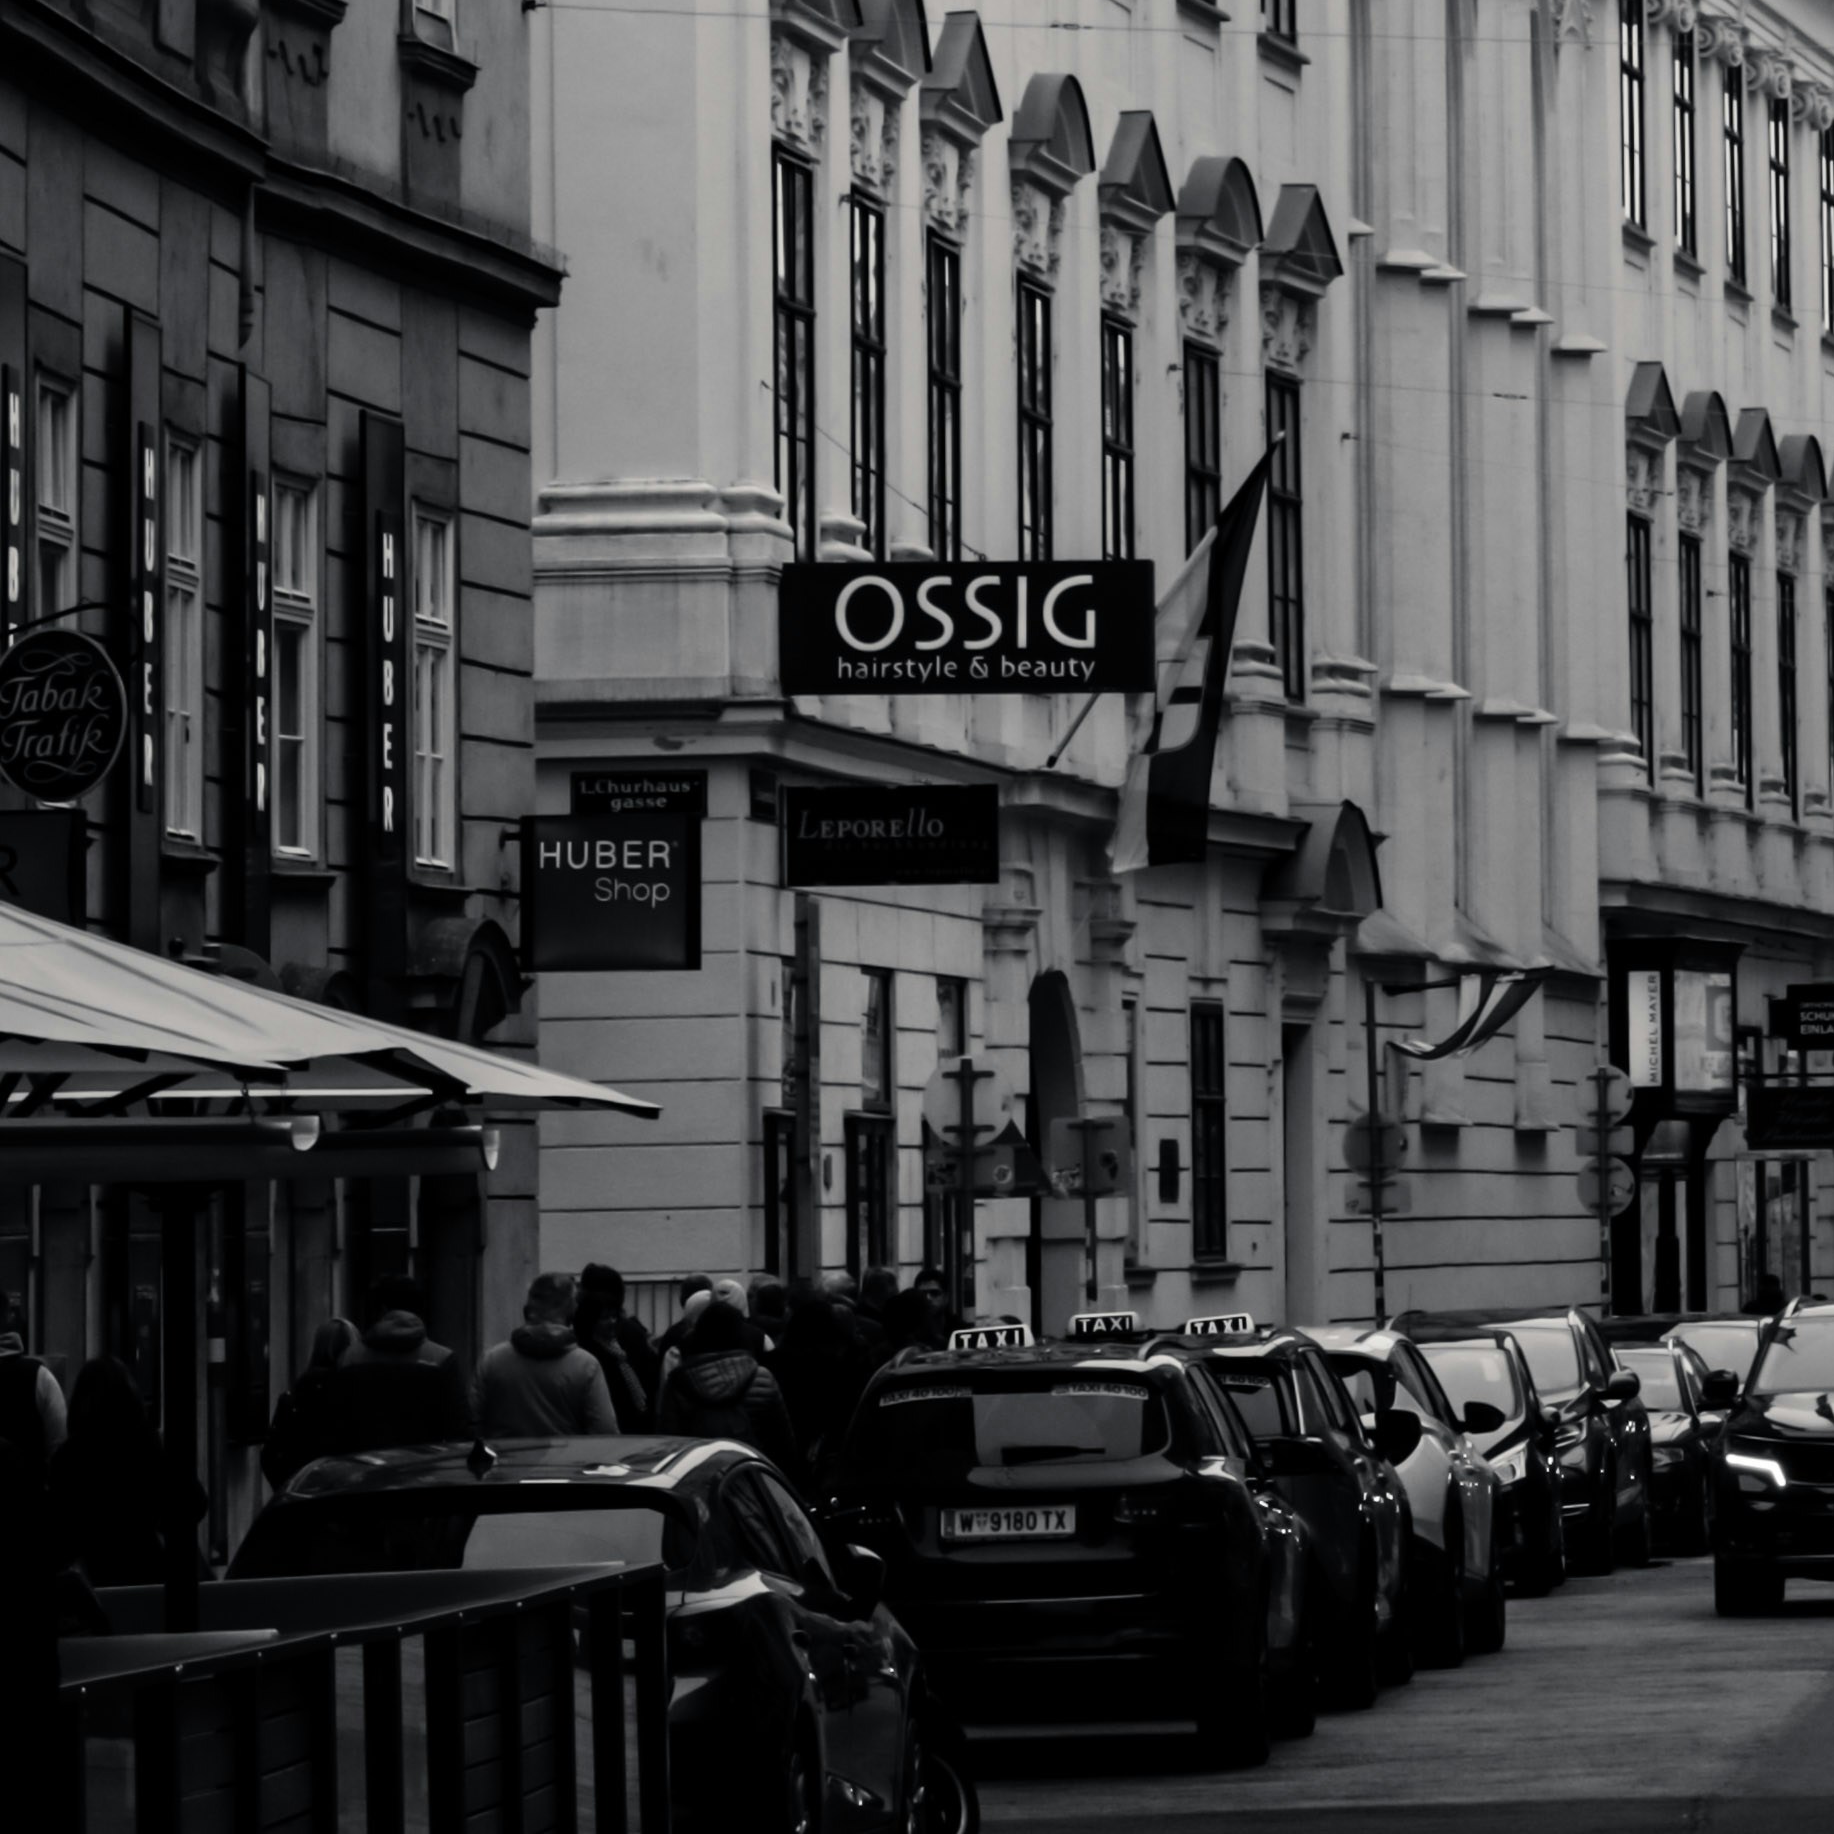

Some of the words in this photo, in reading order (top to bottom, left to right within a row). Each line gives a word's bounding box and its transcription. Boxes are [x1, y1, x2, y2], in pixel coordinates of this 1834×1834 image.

[143, 446, 155, 785] HUBER
[835, 574, 1096, 652] OSSIG
[256, 493, 266, 811] HUBER
[382, 531, 394, 832] HUBER
[838, 655, 959, 683] hairstyle
[969, 655, 989, 680] &
[1001, 655, 1096, 683] beauty
[610, 796, 668, 812] gasse
[594, 877, 671, 909] Shop
[1648, 974, 1658, 1023] MAYER
[1649, 1028, 1658, 1084] MICHEL
[958, 1330, 1020, 1349] TAXI
[1078, 1318, 1131, 1333] TAXI
[1192, 1318, 1248, 1334] TAXI
[960, 1514, 974, 1532] W
[990, 1511, 1037, 1532] 9180
[1041, 1511, 1067, 1530] TX
